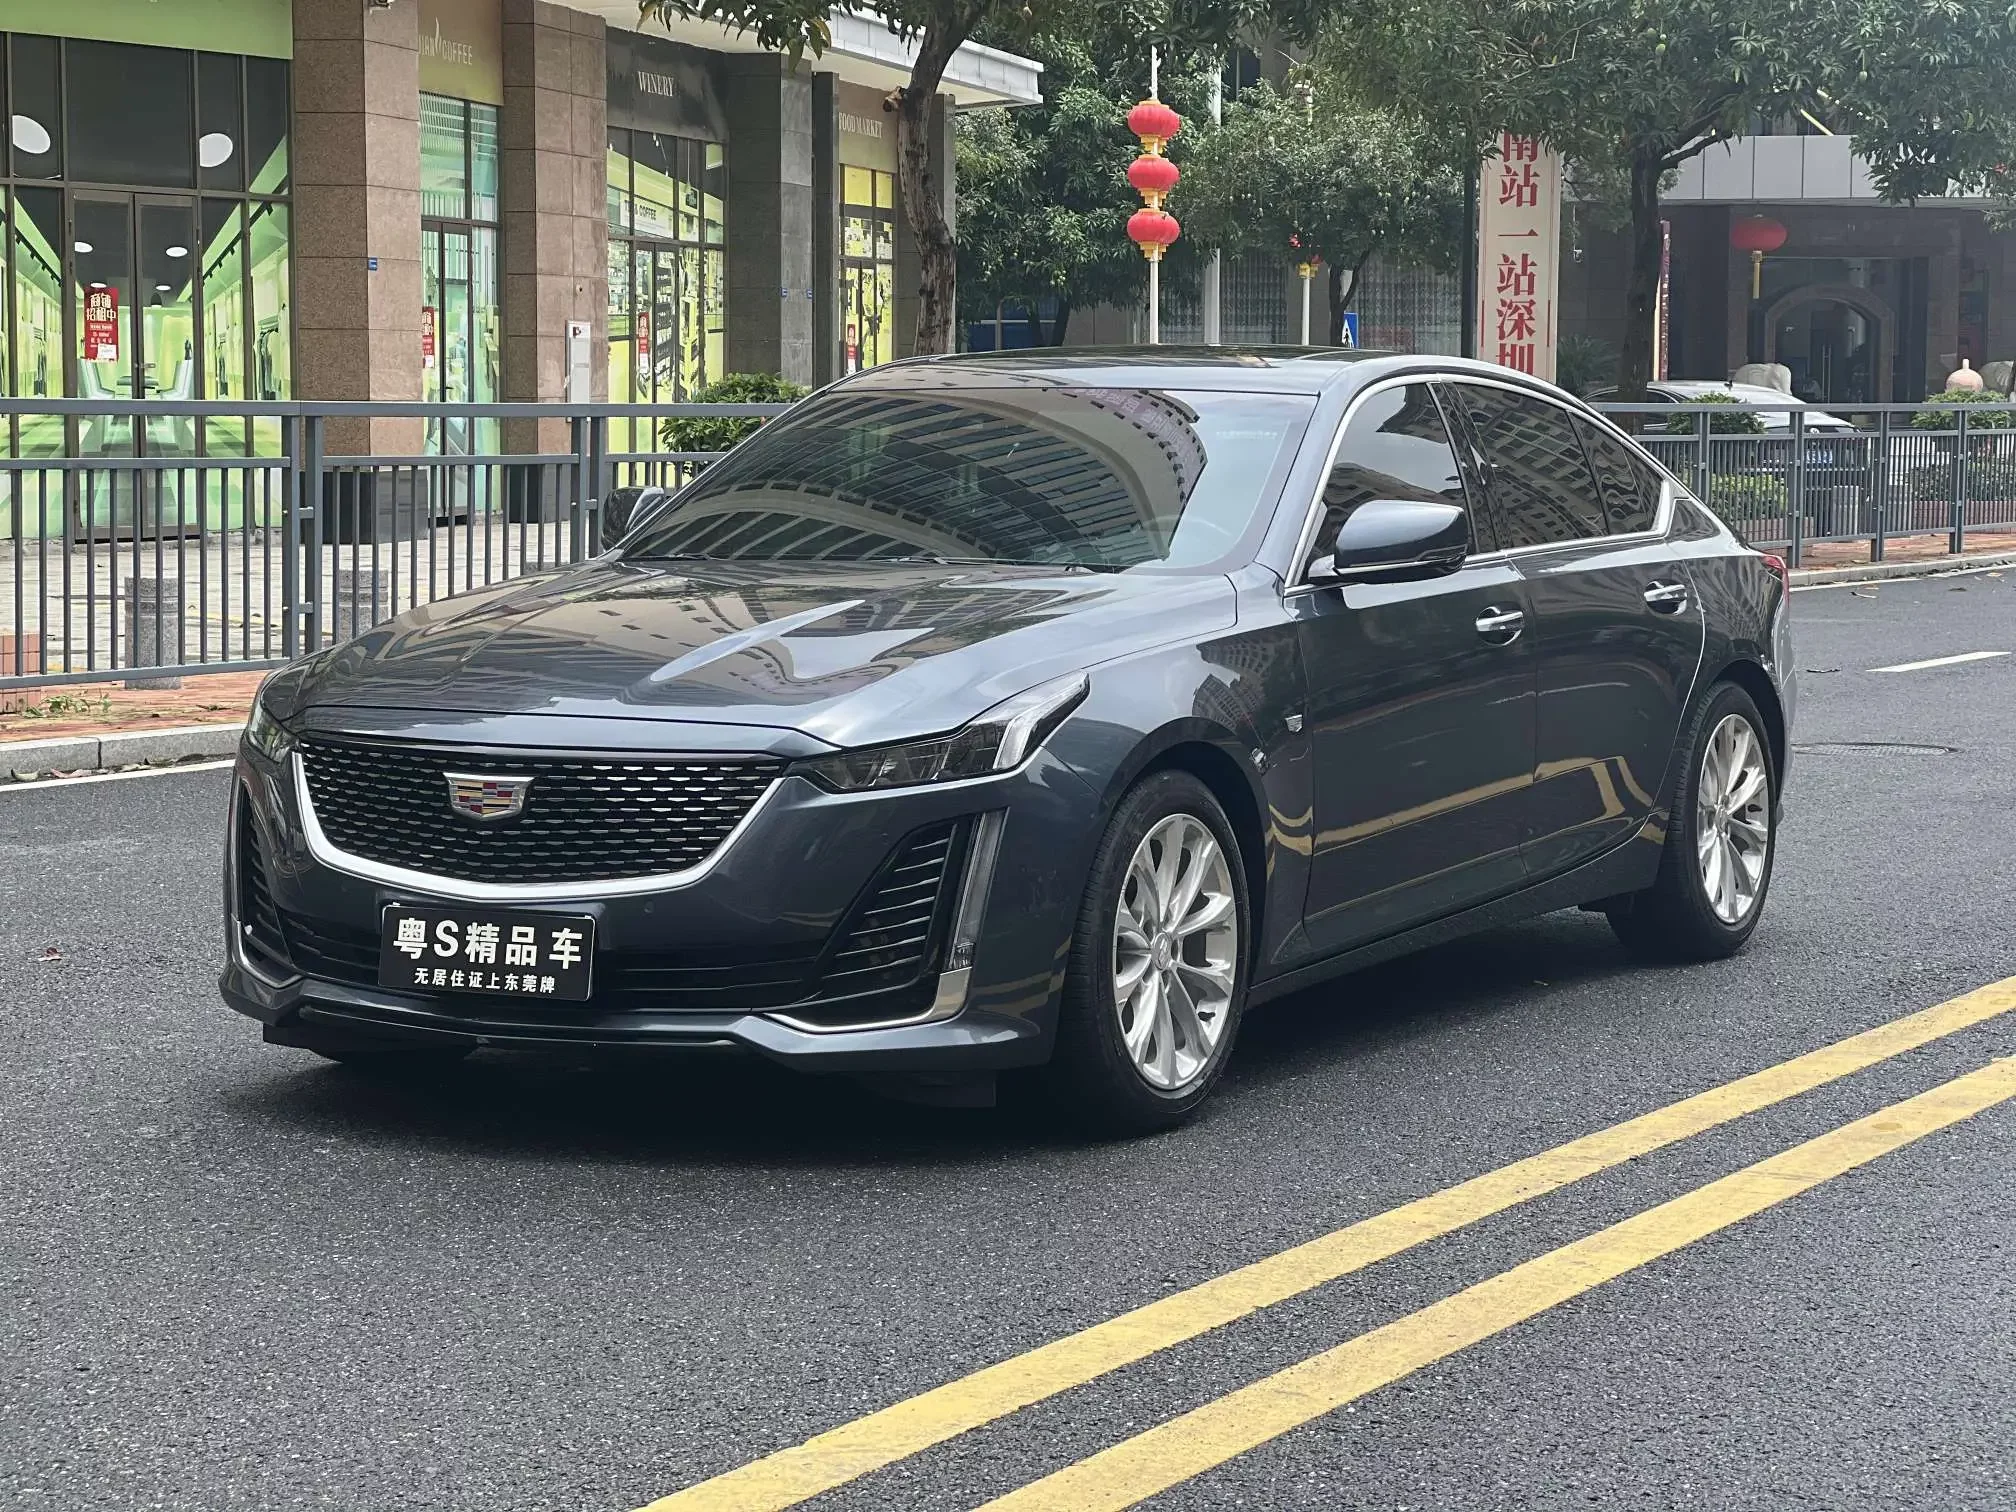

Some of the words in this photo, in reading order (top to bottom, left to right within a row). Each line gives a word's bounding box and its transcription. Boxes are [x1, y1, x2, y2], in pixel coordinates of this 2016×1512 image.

[442, 40, 473, 66] COFFEE
[637, 71, 674, 97] WINERY
[838, 112, 856, 133] FOOD
[856, 116, 883, 139] MARKET
[1496, 130, 1541, 376] 南站一站深圳
[86, 307, 116, 321] 招租中
[393, 917, 583, 970] 粤S精品车
[413, 967, 556, 994] 无居住证上东莞牌
